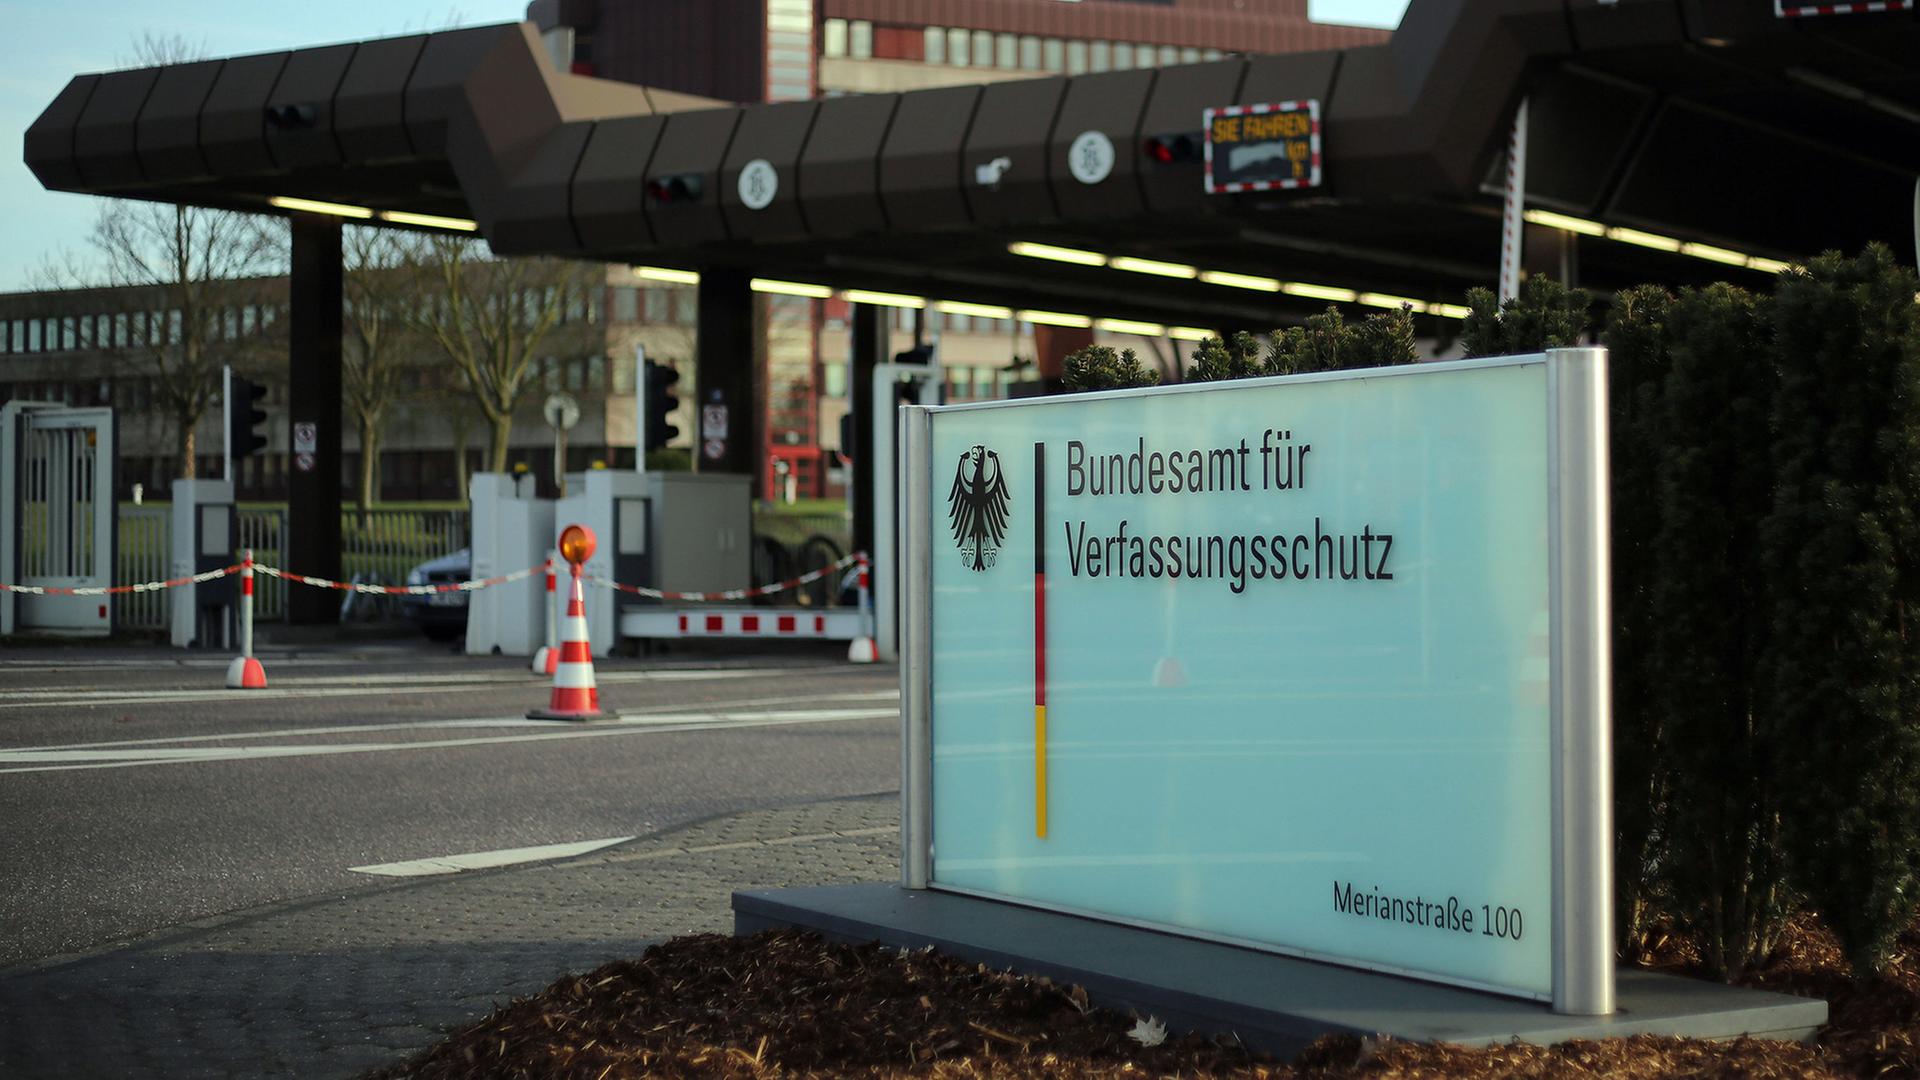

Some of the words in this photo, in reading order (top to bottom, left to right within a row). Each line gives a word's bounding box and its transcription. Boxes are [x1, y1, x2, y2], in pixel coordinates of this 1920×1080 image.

[1213, 118, 1240, 143] SIE
[1067, 436, 1251, 496] Bundesamt
[1260, 429, 1312, 490] für
[1065, 517, 1394, 594] Verfassungsschutz
[1333, 880, 1474, 933] Merianstraße
[1482, 904, 1523, 941] 100
